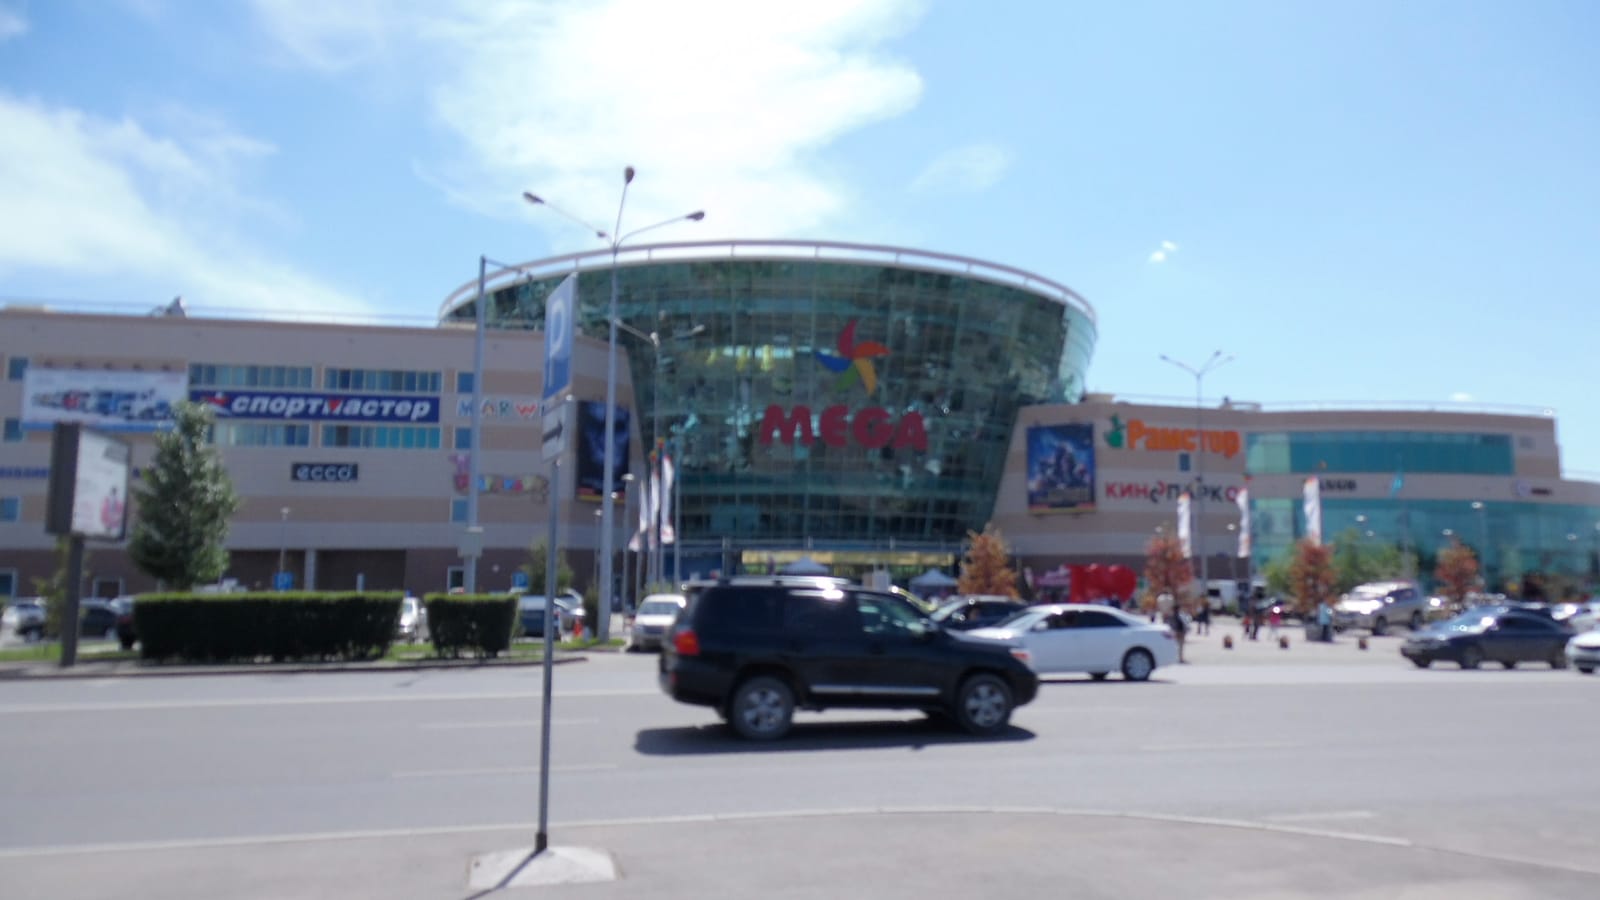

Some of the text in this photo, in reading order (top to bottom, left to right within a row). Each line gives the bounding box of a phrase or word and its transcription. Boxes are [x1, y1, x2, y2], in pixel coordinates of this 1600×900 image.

[759, 404, 929, 451] MEGA
[1127, 419, 1241, 459] Рамстор
[296, 465, 351, 481] ecco
